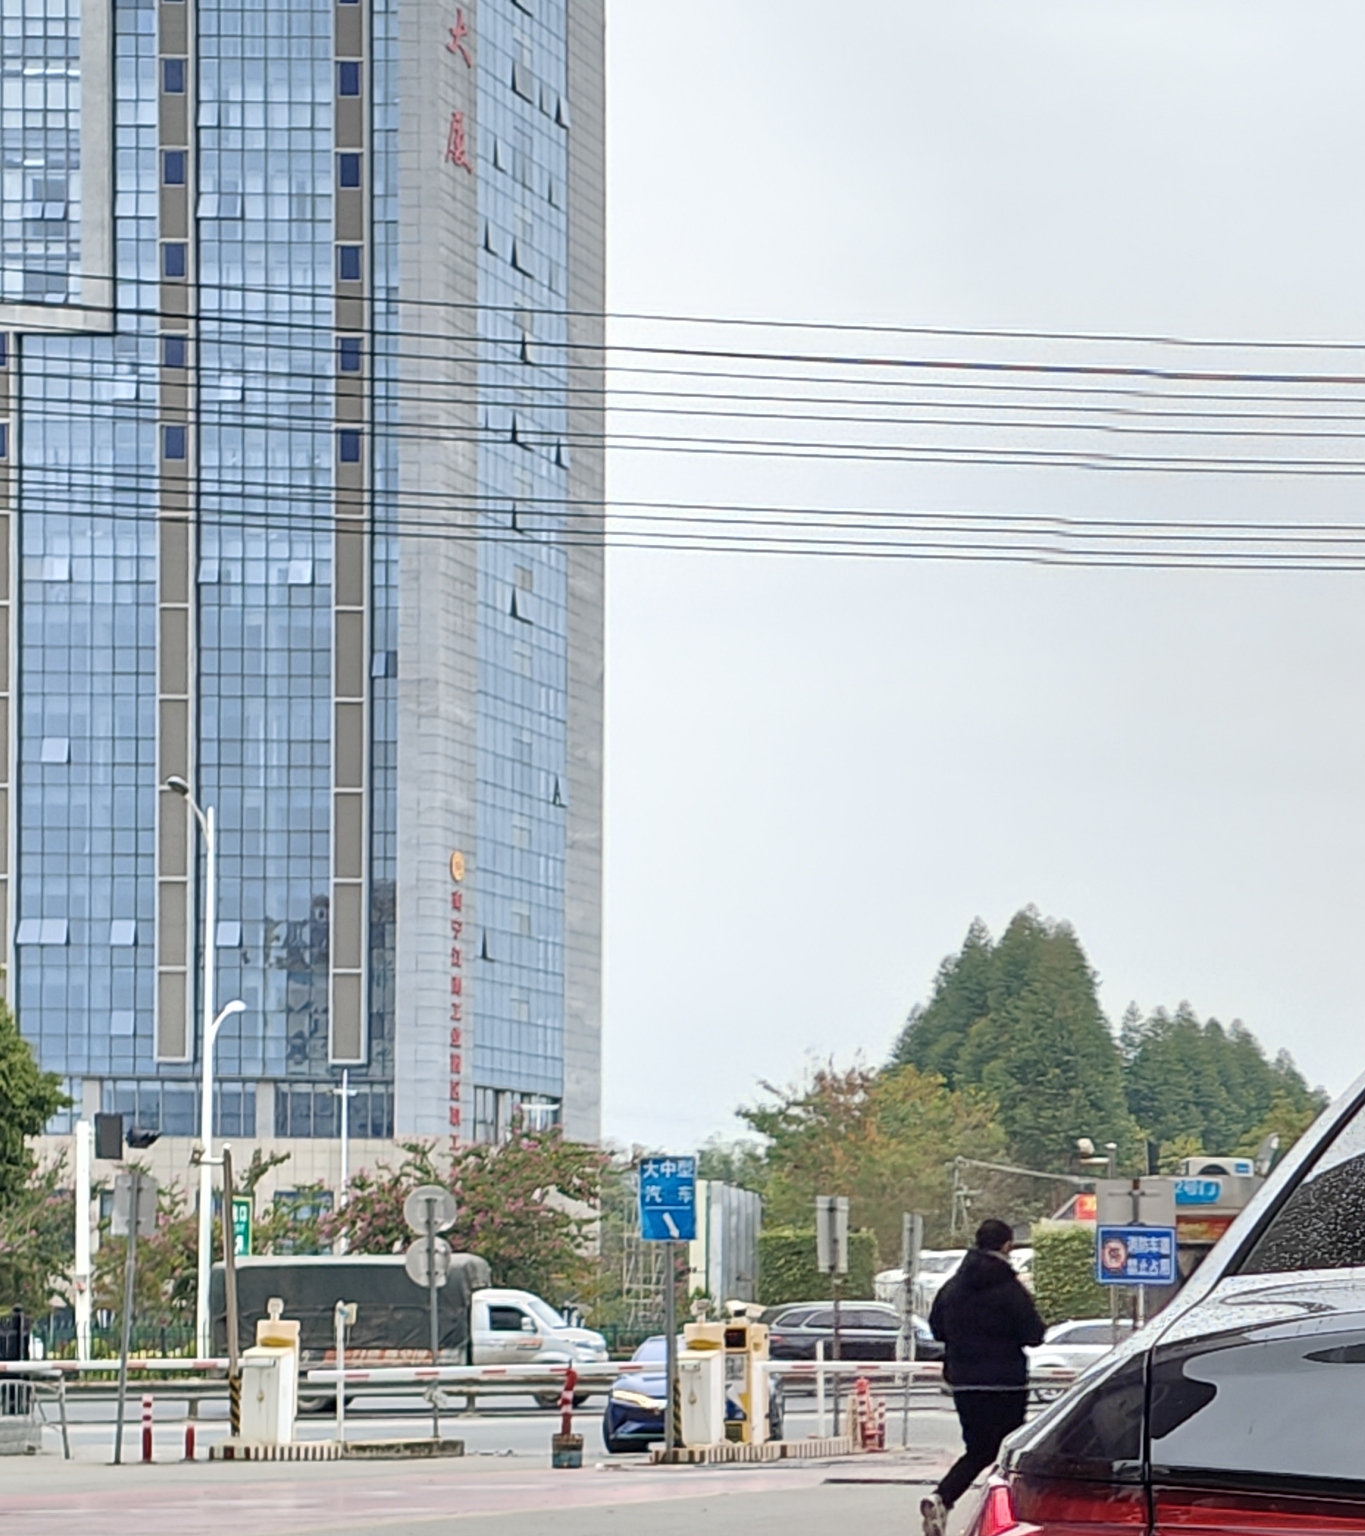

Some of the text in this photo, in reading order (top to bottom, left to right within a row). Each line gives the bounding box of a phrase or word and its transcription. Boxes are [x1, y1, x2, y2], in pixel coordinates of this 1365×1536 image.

[642, 1159, 694, 1179] 大中型
[644, 1185, 694, 1204] 汽车
